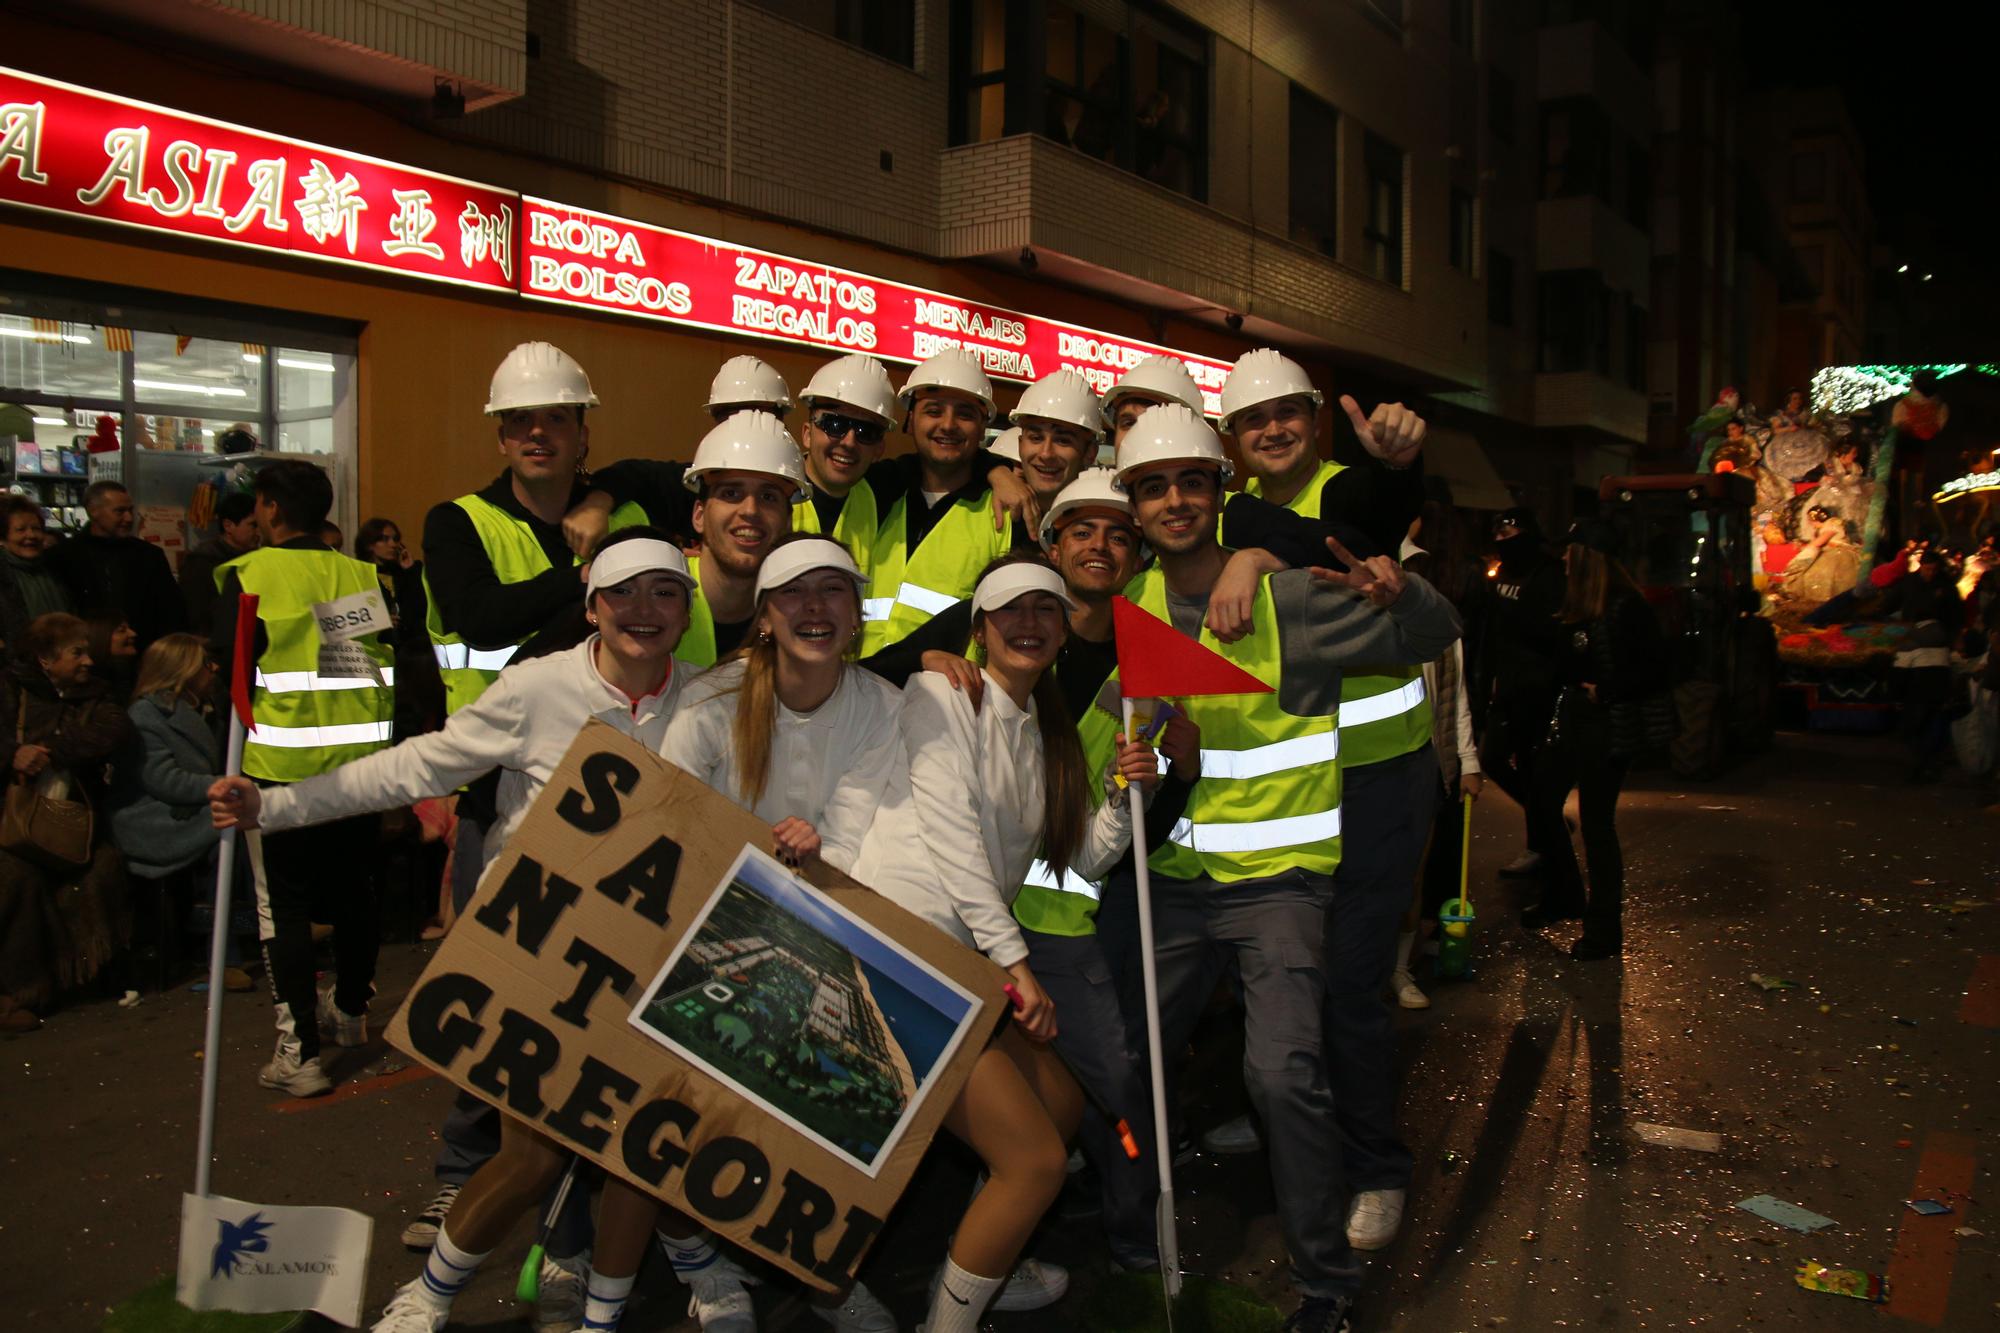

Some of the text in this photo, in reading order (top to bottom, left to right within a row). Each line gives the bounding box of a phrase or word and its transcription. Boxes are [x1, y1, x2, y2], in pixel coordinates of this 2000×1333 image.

[77, 125, 288, 233] ASIA
[530, 211, 646, 266] ROPA
[530, 255, 692, 314] BOLSOS
[734, 257, 876, 314] ZAPATOS
[732, 295, 877, 348] REGALOS
[914, 298, 1027, 346] MENAJES
[407, 972, 884, 1286] GREGORI
